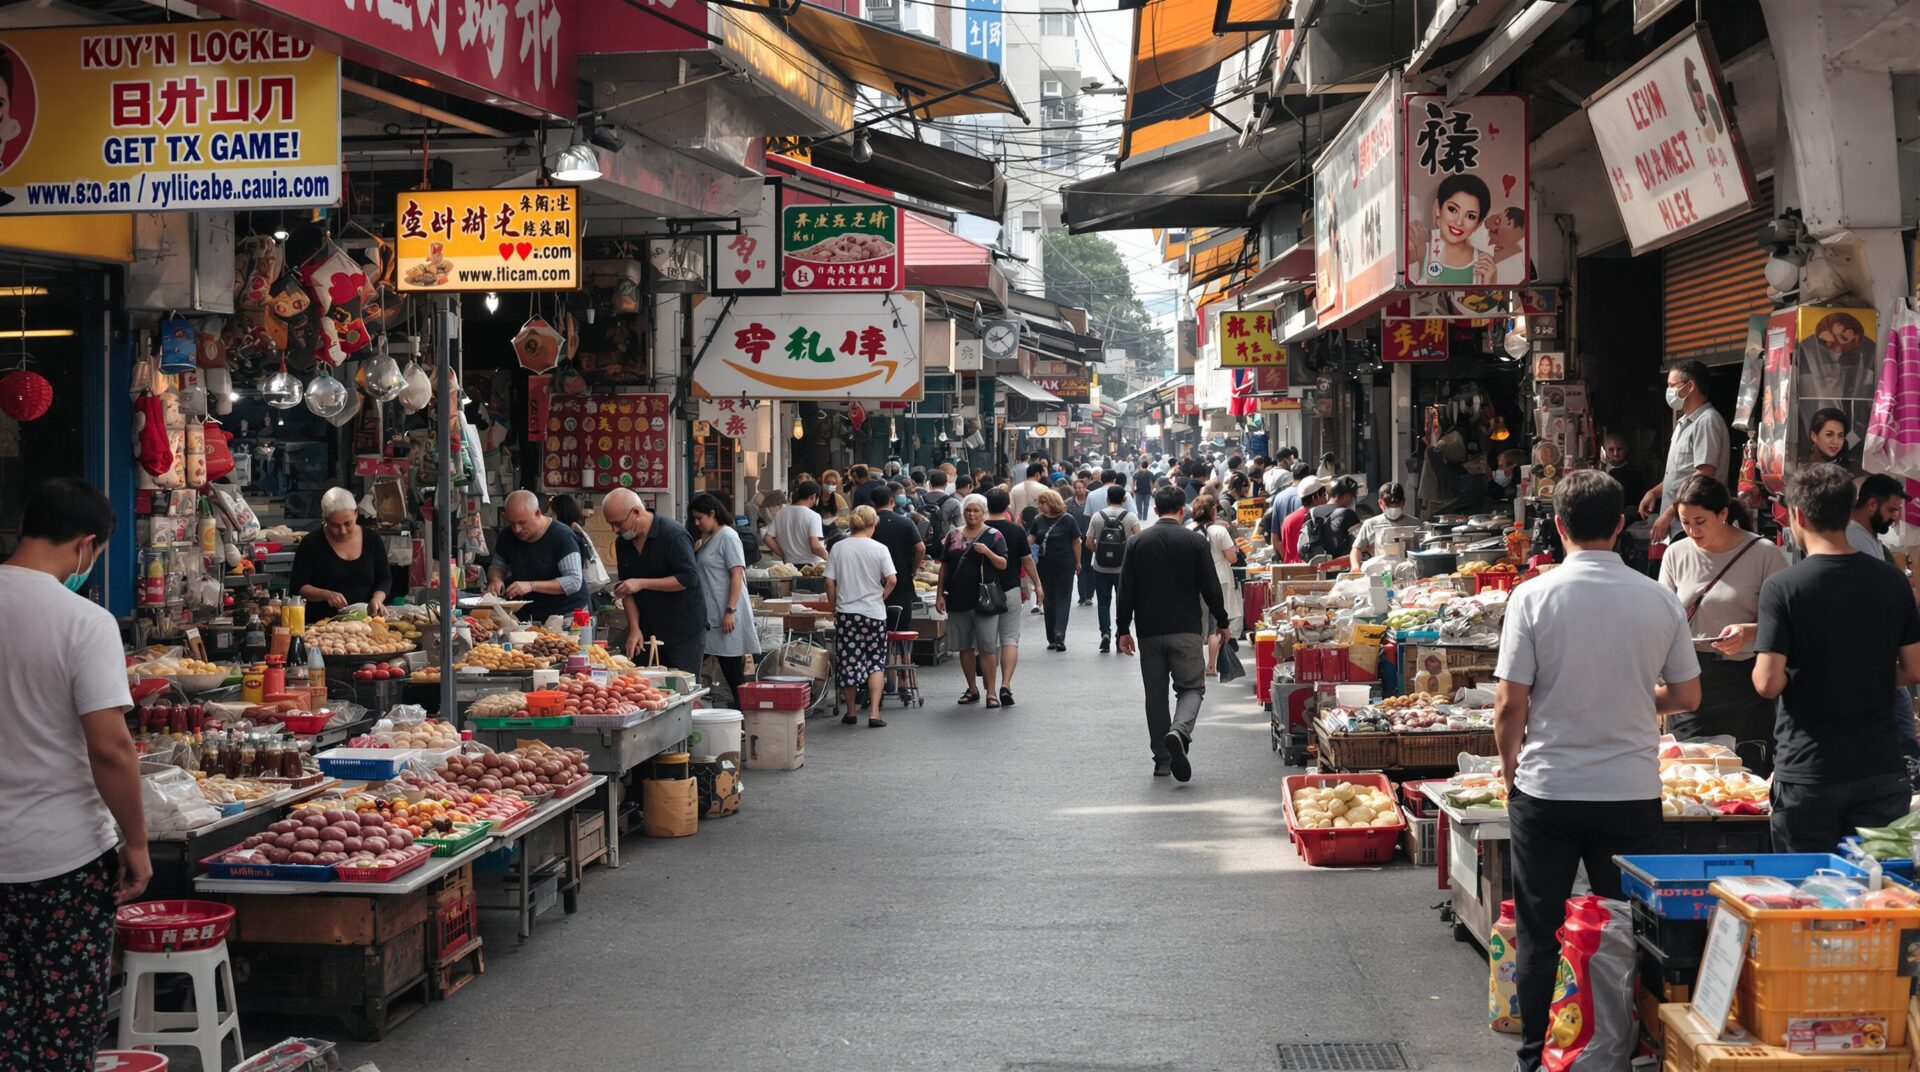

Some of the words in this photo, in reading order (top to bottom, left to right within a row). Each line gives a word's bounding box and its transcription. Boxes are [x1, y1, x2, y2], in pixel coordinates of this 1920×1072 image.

[190, 29, 312, 63] LOCKED
[104, 137, 157, 165] GET
[166, 135, 202, 162] TX
[211, 131, 299, 160] GAME!
